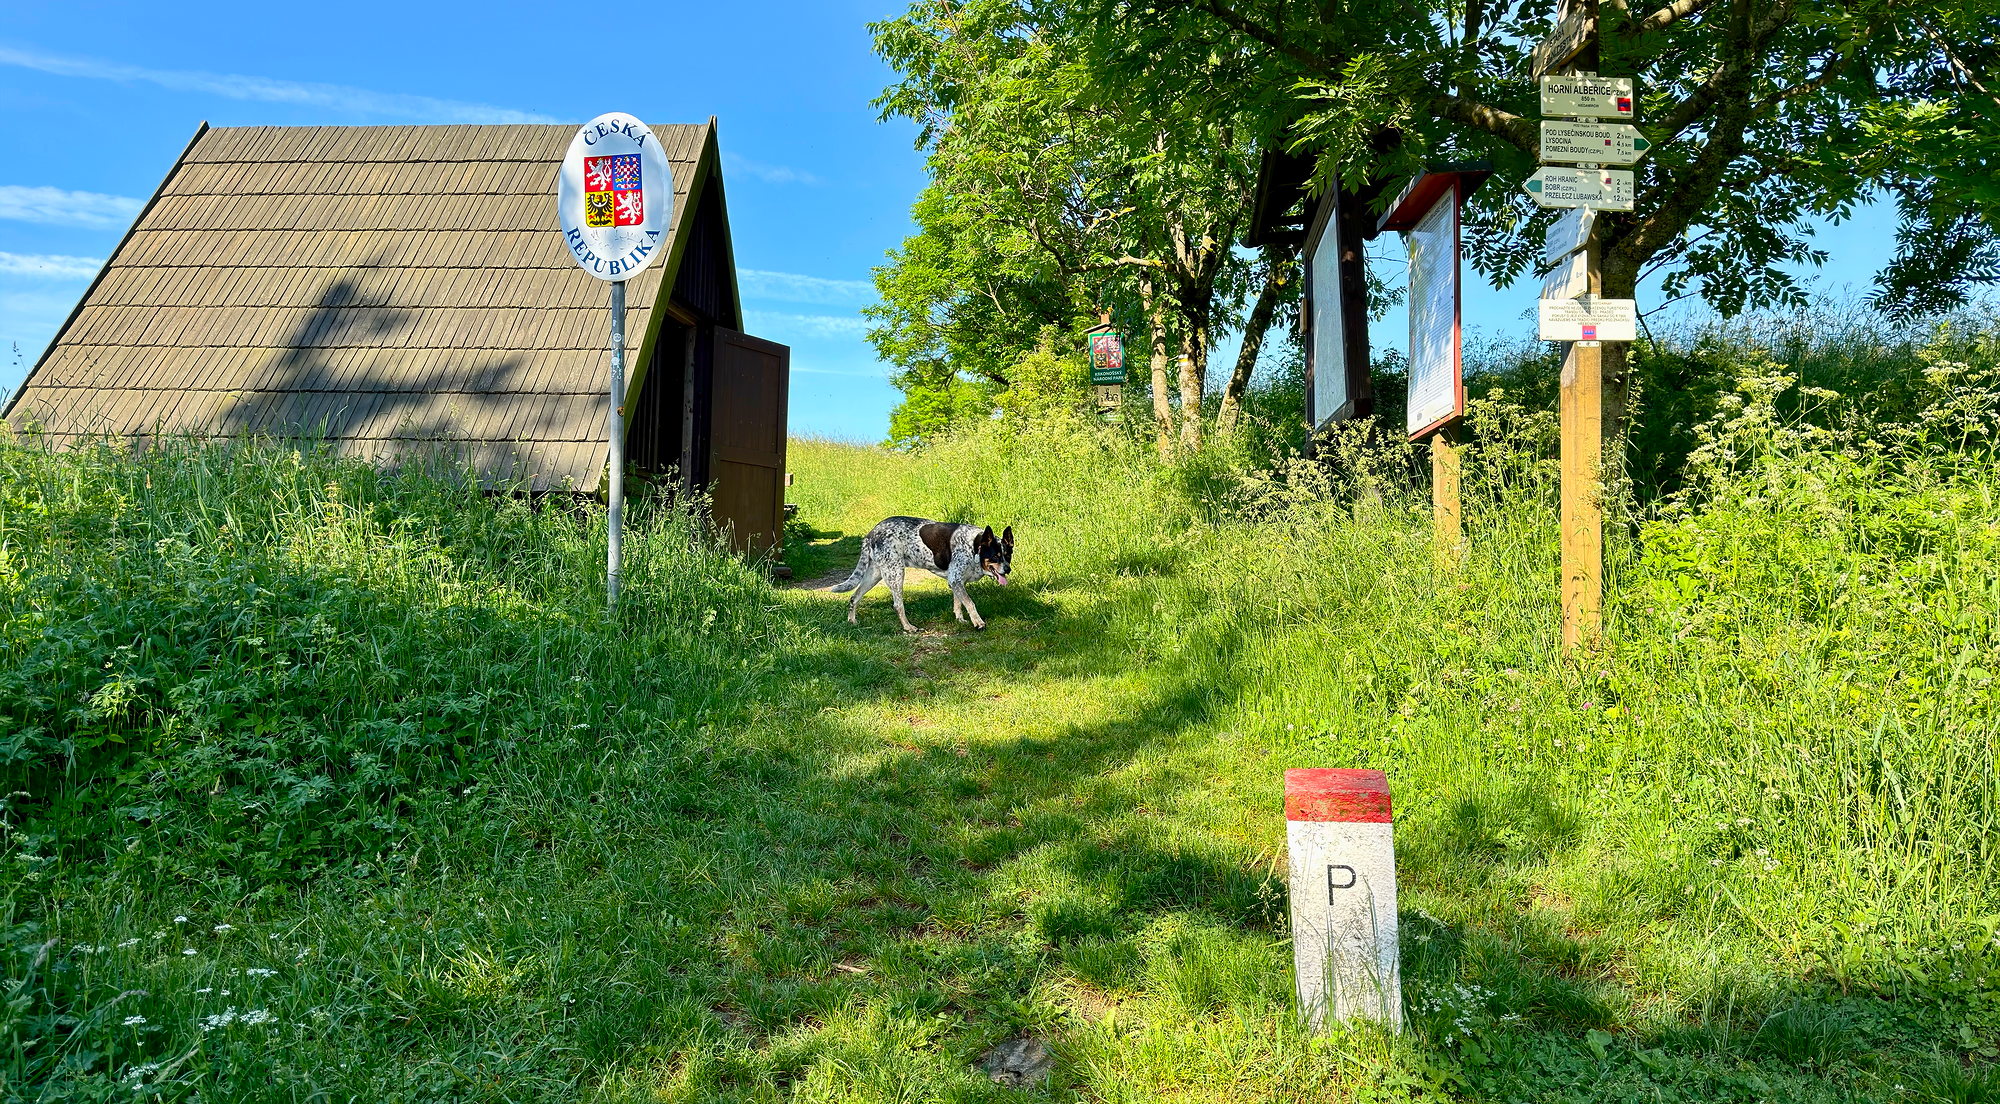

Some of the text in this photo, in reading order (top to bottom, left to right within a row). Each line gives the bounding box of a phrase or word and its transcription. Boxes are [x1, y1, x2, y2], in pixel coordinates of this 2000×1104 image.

[1548, 83, 1572, 94] HORNÍ
[1573, 84, 1611, 96] ALBEŘICE
[583, 118, 651, 149] ČESKÁ
[1545, 145, 1569, 153] POMEZNÍ
[1573, 193, 1603, 201] LUBAWSKA
[566, 226, 661, 276] REPUBLIKA
[1326, 864, 1357, 906] P
